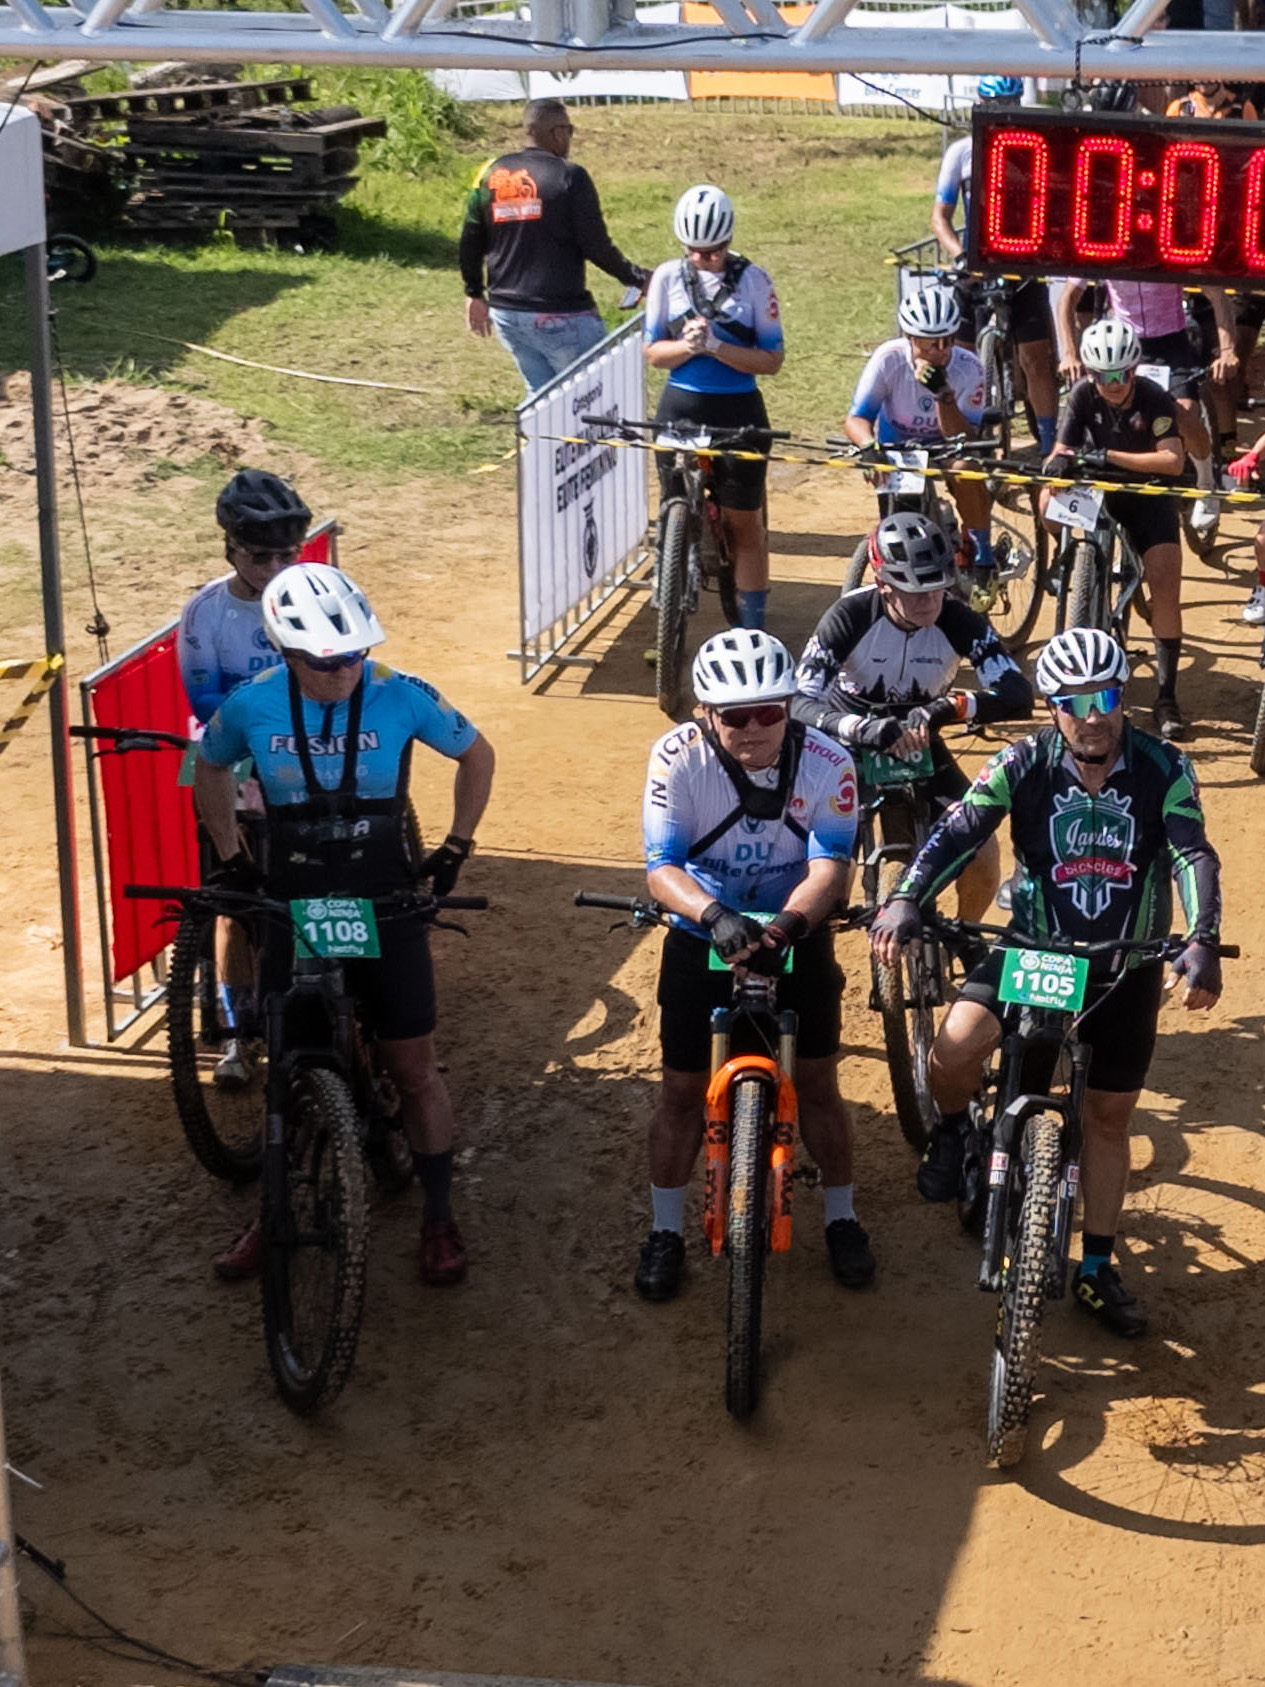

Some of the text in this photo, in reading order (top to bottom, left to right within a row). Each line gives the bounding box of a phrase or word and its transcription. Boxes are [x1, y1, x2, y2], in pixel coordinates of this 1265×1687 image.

[1069, 500, 1079, 513] 6
[269, 730, 381, 756] FUSION
[735, 841, 775, 862] DU
[327, 900, 358, 909] COPA
[304, 920, 369, 942] 1108
[1012, 970, 1075, 996] 1105
